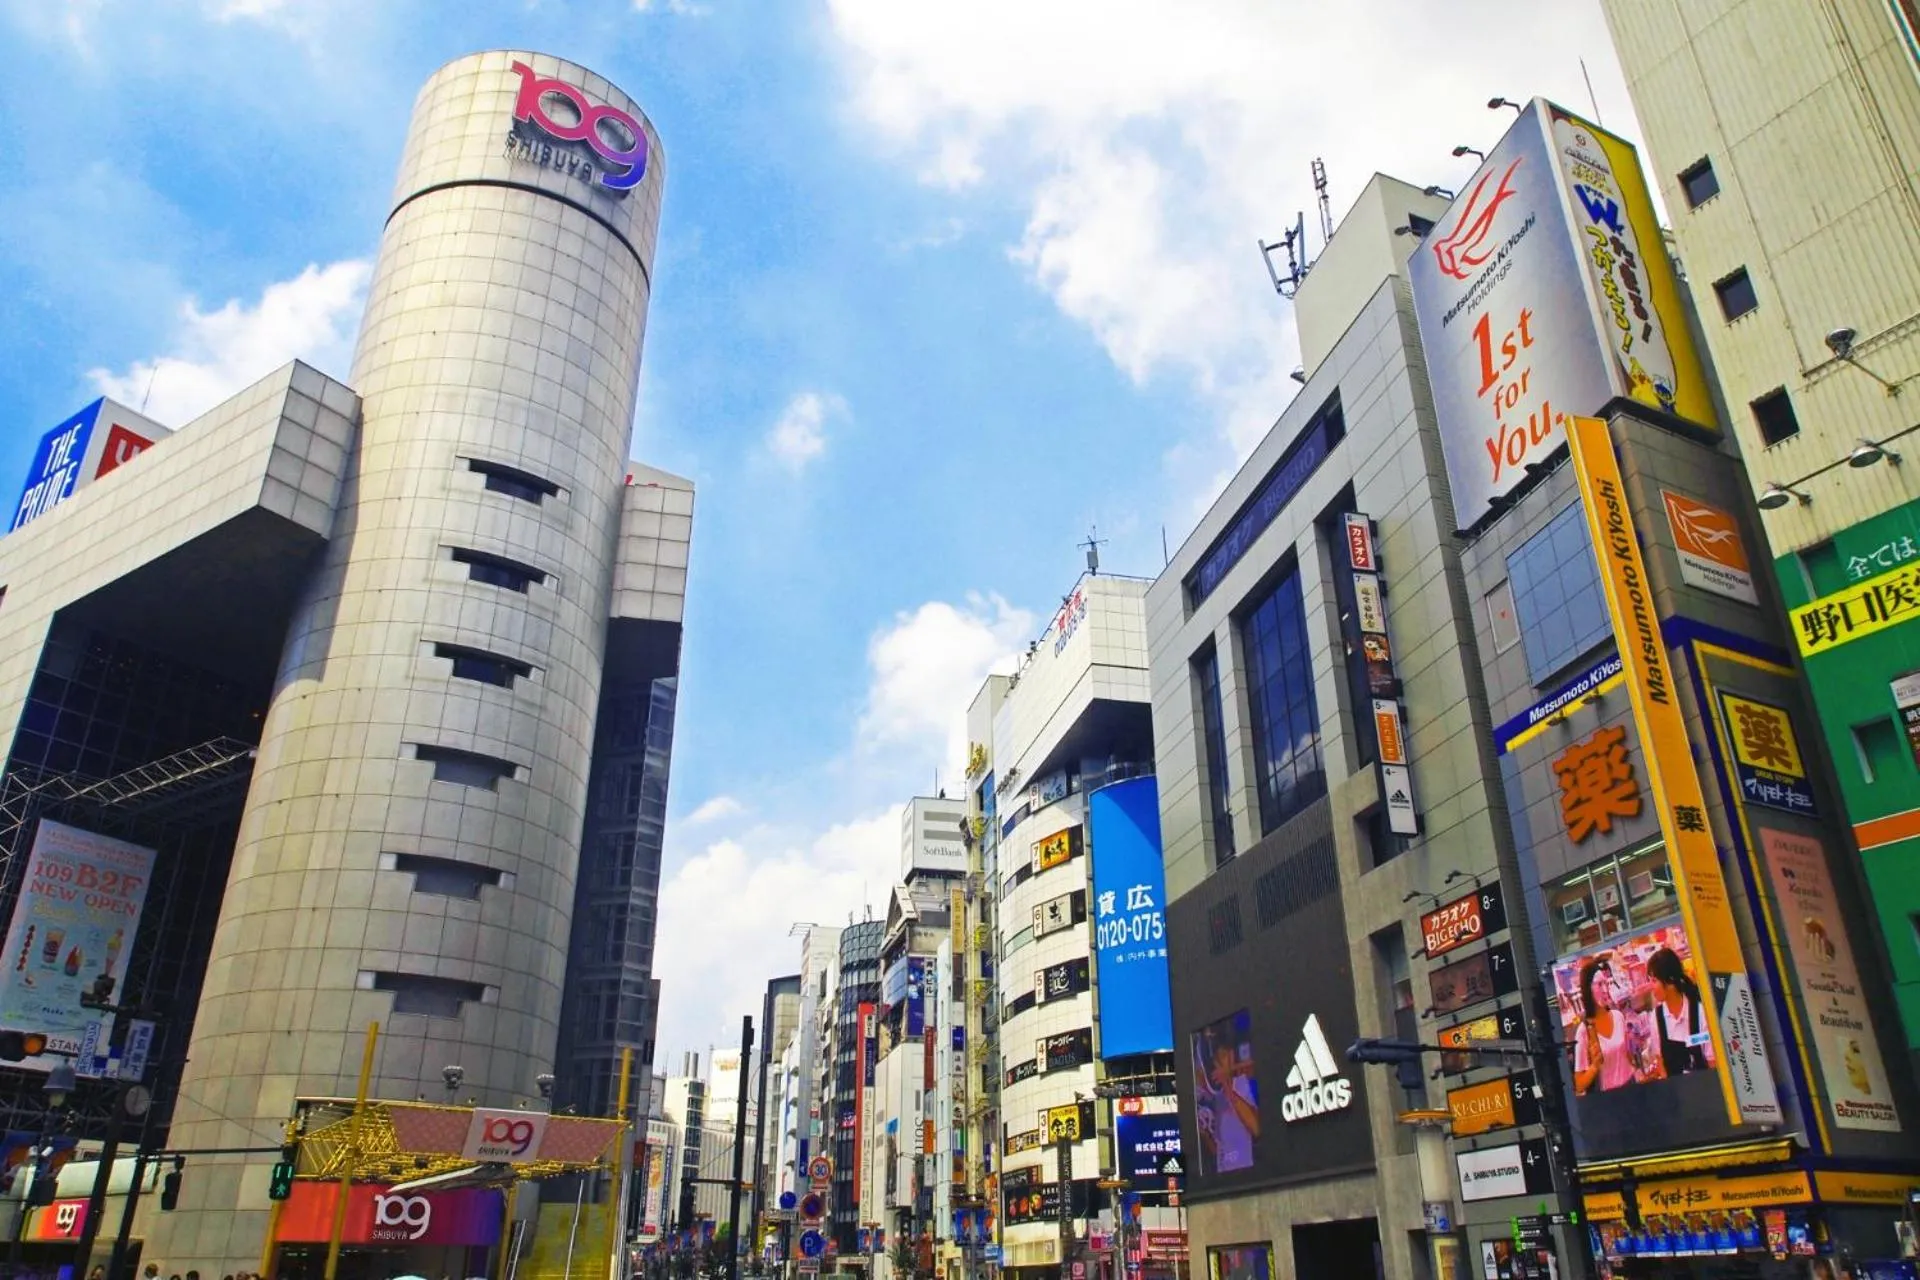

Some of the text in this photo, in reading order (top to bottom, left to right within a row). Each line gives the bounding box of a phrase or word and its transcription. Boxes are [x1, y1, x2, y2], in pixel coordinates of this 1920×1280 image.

[511, 59, 650, 191] 109
[506, 130, 593, 182] SHIBUYA
[1442, 212, 1536, 328] Matsumoto KiYoshi
[1467, 259, 1513, 316] Holdings
[1473, 307, 1535, 398] 1st
[1493, 367, 1531, 420] for
[42, 422, 82, 479] THE
[13, 461, 78, 530] PRIME
[1351, 527, 1367, 567] カラオケ
[1684, 557, 1723, 580] Matsumoto
[1847, 536, 1918, 581] 全ては
[1596, 478, 1670, 706] Matsumoto KiYoshi
[1703, 574, 1736, 591] Holdings
[1800, 567, 1920, 648] 野口医
[1529, 659, 1624, 724] Matsumoto KiYos
[1733, 704, 1793, 770] 薬
[1552, 725, 1642, 845] 薬
[1674, 804, 1706, 834] 薬
[922, 845, 963, 857] SoftBank
[30, 880, 138, 917] NEW OPEN
[34, 861, 143, 898] 109 B2F
[1425, 914, 1481, 951] BIG ECHO
[1431, 900, 1470, 931] カラオケ
[1282, 1078, 1353, 1122] adidas
[483, 1117, 534, 1156] 109
[1040, 1114, 1047, 1139] 3F
[477, 1145, 510, 1155] SHIBUYA
[1721, 1189, 1770, 1200] Matsumoto
[1770, 1184, 1805, 1197] KiYoshi
[372, 1230, 408, 1240] SHIBUYA
[374, 1194, 431, 1240] 109
